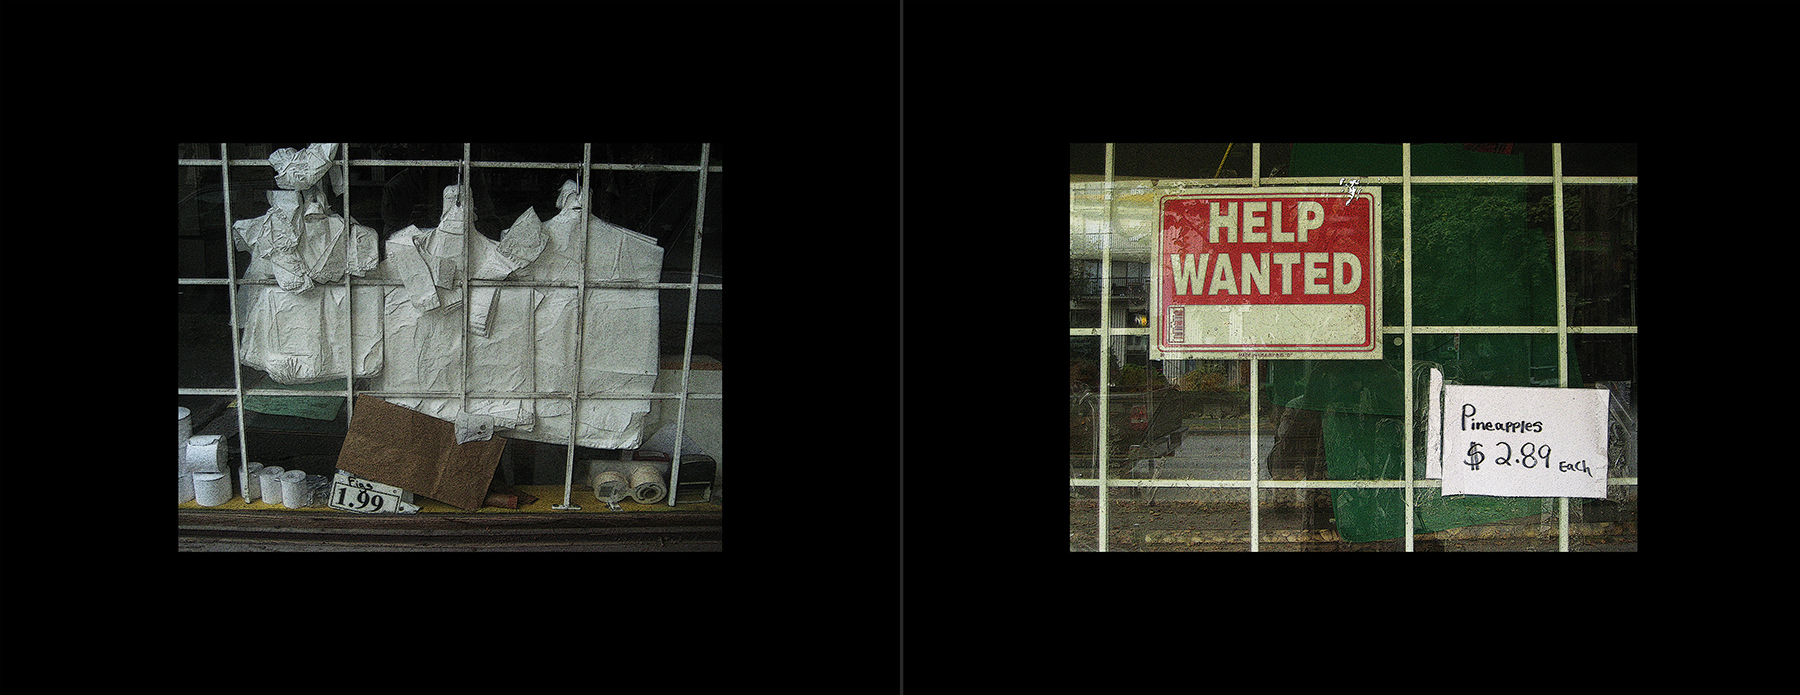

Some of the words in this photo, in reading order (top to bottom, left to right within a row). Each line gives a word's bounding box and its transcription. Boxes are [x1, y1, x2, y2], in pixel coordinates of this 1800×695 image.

[1209, 201, 1325, 243] HELP
[1170, 252, 1362, 295] WANTED
[1461, 403, 1543, 433] Pineapples
[335, 487, 384, 512] 1.99
[347, 476, 373, 493] Figs
